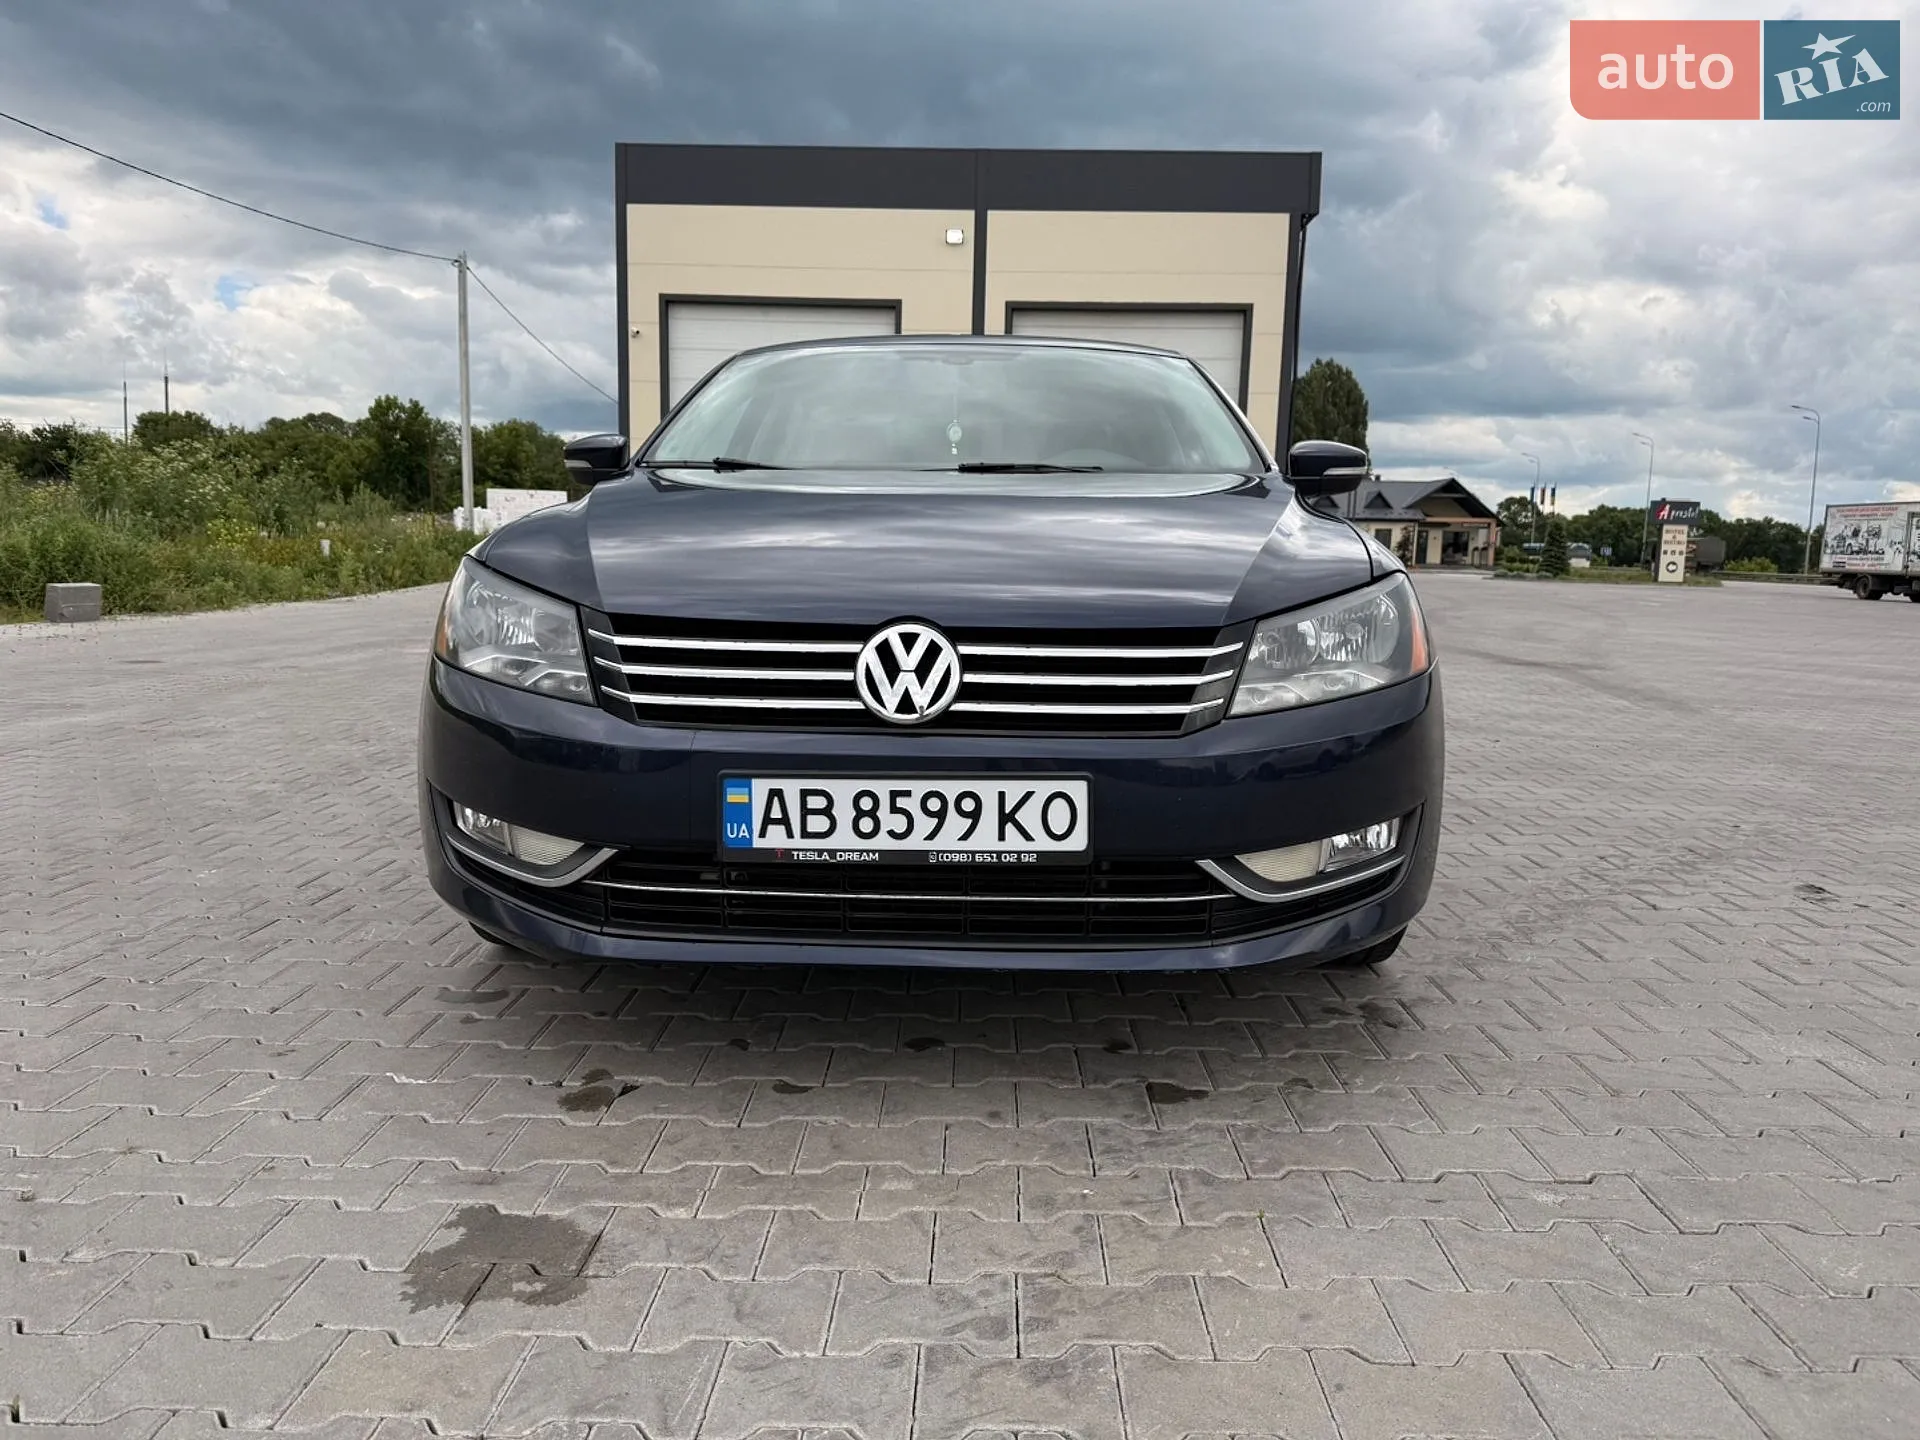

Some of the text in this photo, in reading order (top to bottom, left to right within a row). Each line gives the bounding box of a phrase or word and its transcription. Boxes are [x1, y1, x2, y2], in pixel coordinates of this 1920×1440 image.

[856, 624, 961, 724] VW
[758, 788, 1079, 843] AB 8599 KO
[726, 822, 750, 839] UA
[791, 851, 879, 864] TESLA_DREAM
[938, 852, 1038, 863] (098) 651 02 92
